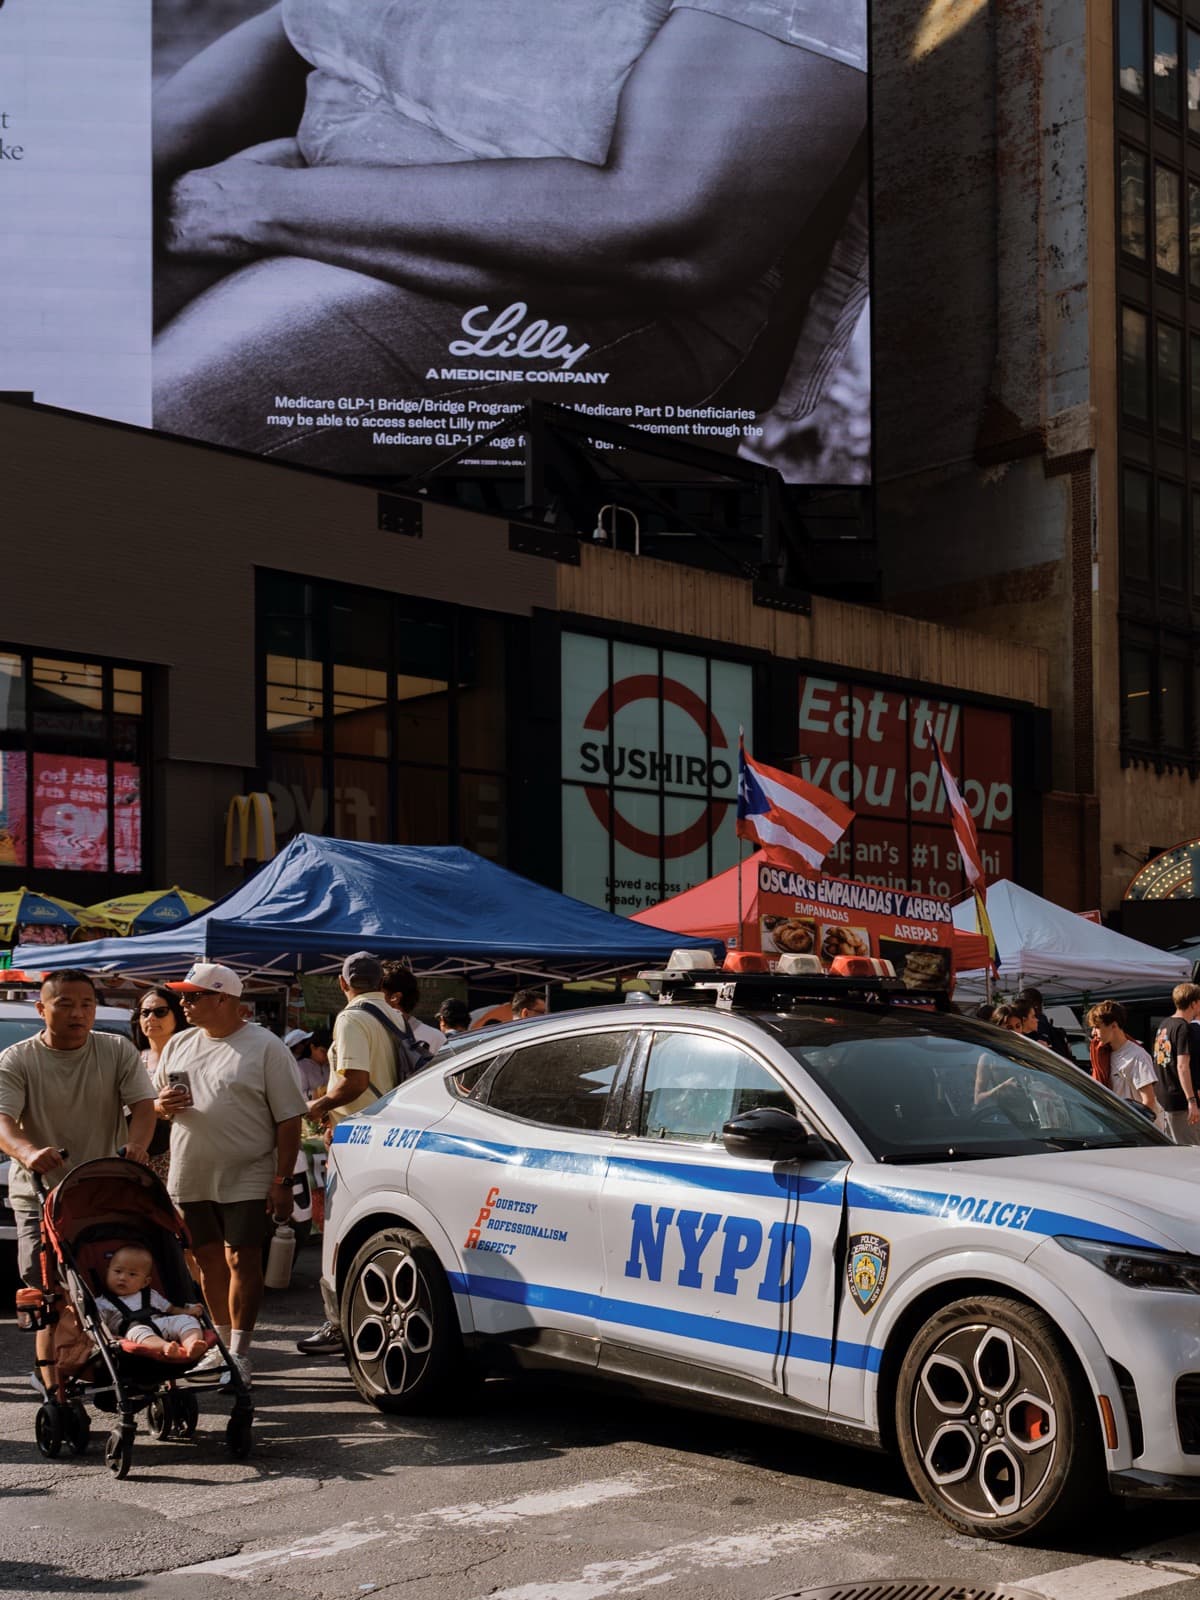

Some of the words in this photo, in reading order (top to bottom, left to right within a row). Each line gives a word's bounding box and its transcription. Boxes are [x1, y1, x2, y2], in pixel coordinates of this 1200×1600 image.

[448, 302, 590, 368] Lilly
[425, 368, 439, 380] A
[440, 368, 524, 383] MEDICINE
[525, 371, 610, 384] COMPANY
[275, 396, 335, 410] Medicare
[338, 397, 375, 410] GLP-1
[378, 398, 465, 415] Bridge/Bridge
[574, 403, 632, 417] Medicare
[635, 404, 661, 418] Part
[664, 406, 675, 418] D
[677, 405, 755, 420] beneficiaries
[267, 414, 294, 430] may
[297, 414, 313, 426] be
[316, 415, 343, 427] able
[346, 416, 359, 427] to
[362, 418, 406, 429] access
[408, 416, 446, 429] select
[449, 417, 475, 432] Lilly
[692, 423, 739, 439] through
[743, 425, 763, 437] the
[373, 433, 432, 446] Medicare
[435, 434, 472, 446] GLP-1
[798, 676, 888, 742] Eat
[580, 742, 732, 789] SUSHIRO
[827, 840, 899, 867] apan's
[912, 843, 939, 870] #1
[760, 866, 816, 899] OSCAR'S
[817, 880, 891, 916] EMPANADAS
[894, 898, 903, 917] Y
[905, 900, 952, 923] AREPAS
[928, 876, 950, 898] to
[795, 902, 849, 923] EMPANADAS
[894, 924, 939, 942] AREPAS
[383, 1127, 397, 1147] 32
[397, 1129, 420, 1149] PCT
[485, 1187, 537, 1215] COURTESY
[941, 1194, 1033, 1229] POLICE
[475, 1207, 568, 1243] PROFESSIONALISM
[464, 1229, 517, 1256] RESPECT
[624, 1203, 811, 1303] NYPD
[851, 1244, 887, 1260] DEPARTMENT
[860, 1235, 879, 1246] POLICE
[871, 1287, 881, 1303] NEW
[879, 1266, 887, 1285] YORK
